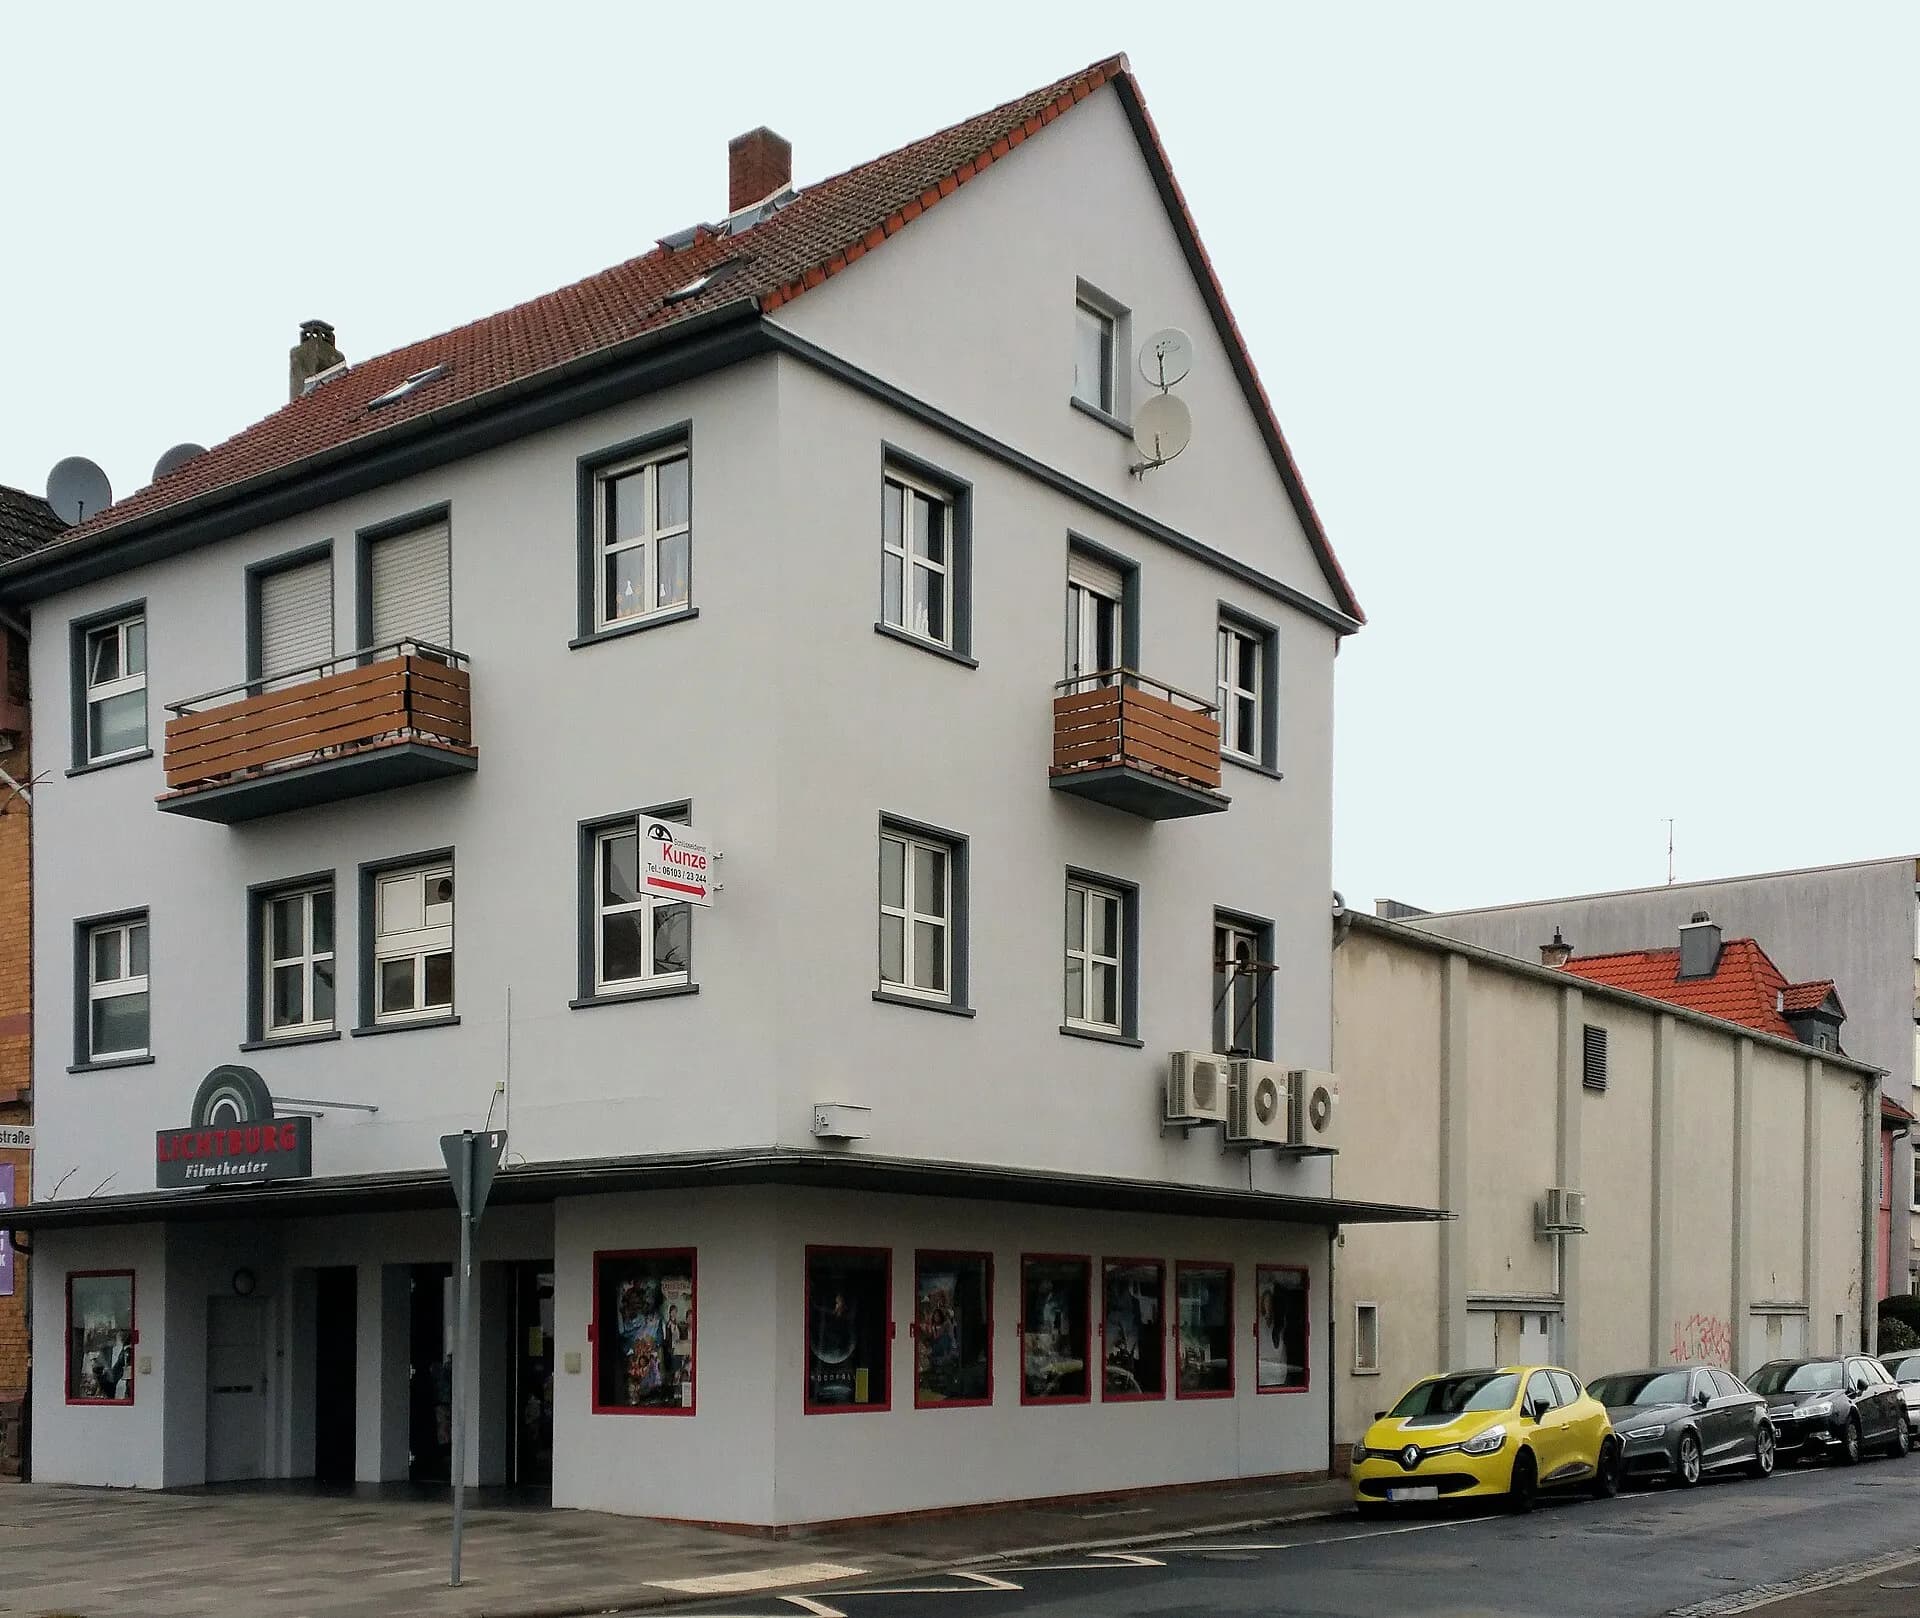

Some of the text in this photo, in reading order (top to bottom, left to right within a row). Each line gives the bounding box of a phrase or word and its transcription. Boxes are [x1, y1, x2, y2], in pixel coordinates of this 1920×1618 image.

[663, 843, 706, 870] Kunze
[662, 866, 681, 878] 06103
[687, 871, 694, 881] 23
[695, 873, 707, 883] 244
[158, 1123, 296, 1163] LICHTBURG
[185, 1161, 268, 1179] Filmtheater
